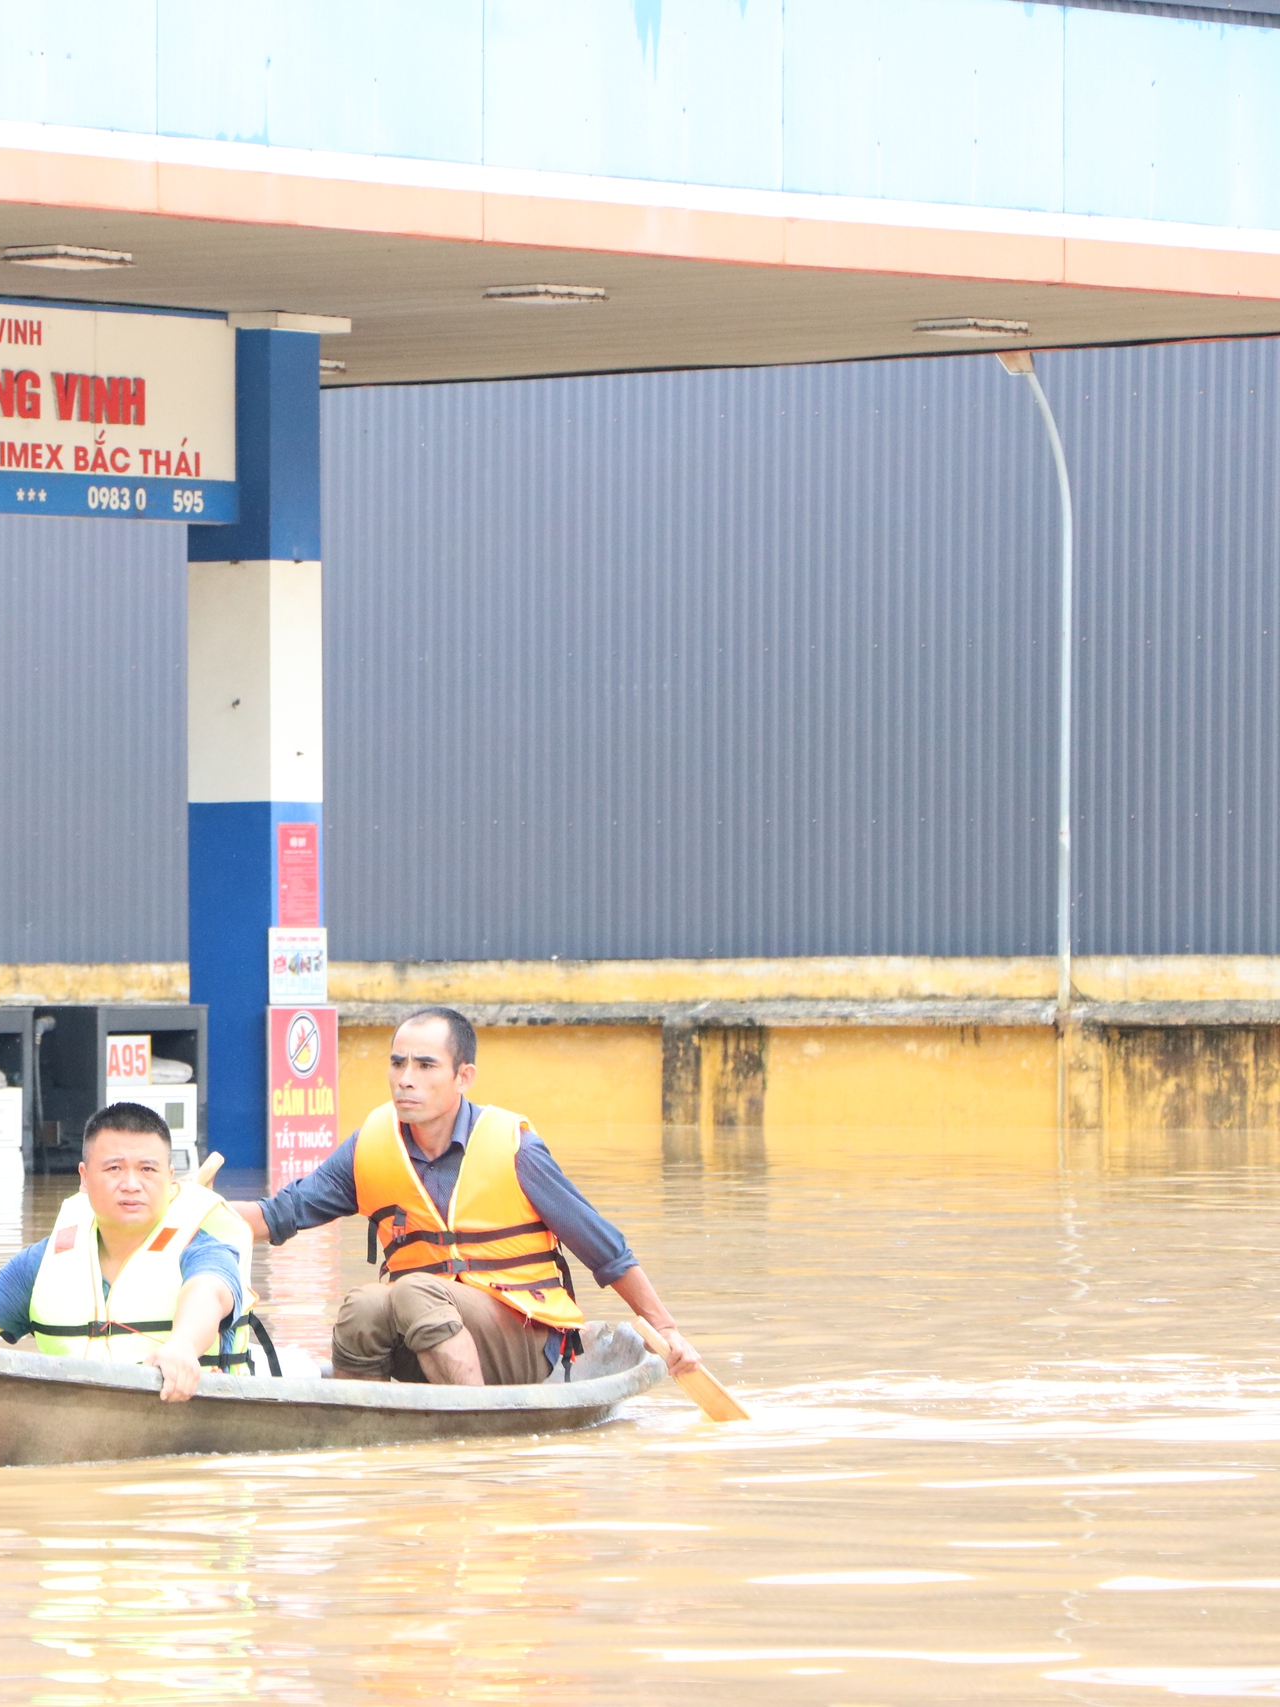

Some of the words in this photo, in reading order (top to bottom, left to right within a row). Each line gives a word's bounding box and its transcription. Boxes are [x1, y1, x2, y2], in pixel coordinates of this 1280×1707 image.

[51, 371, 146, 426] VINH
[74, 429, 131, 474] BẮC
[139, 437, 200, 477] THÁI
[87, 485, 131, 511] 0983
[172, 489, 205, 514] 595
[107, 1043, 148, 1077] A95
[273, 1079, 305, 1117] CẤM
[308, 1077, 335, 1116] LỬA
[275, 1122, 295, 1149] TẮT
[297, 1124, 333, 1149] THUỐC
